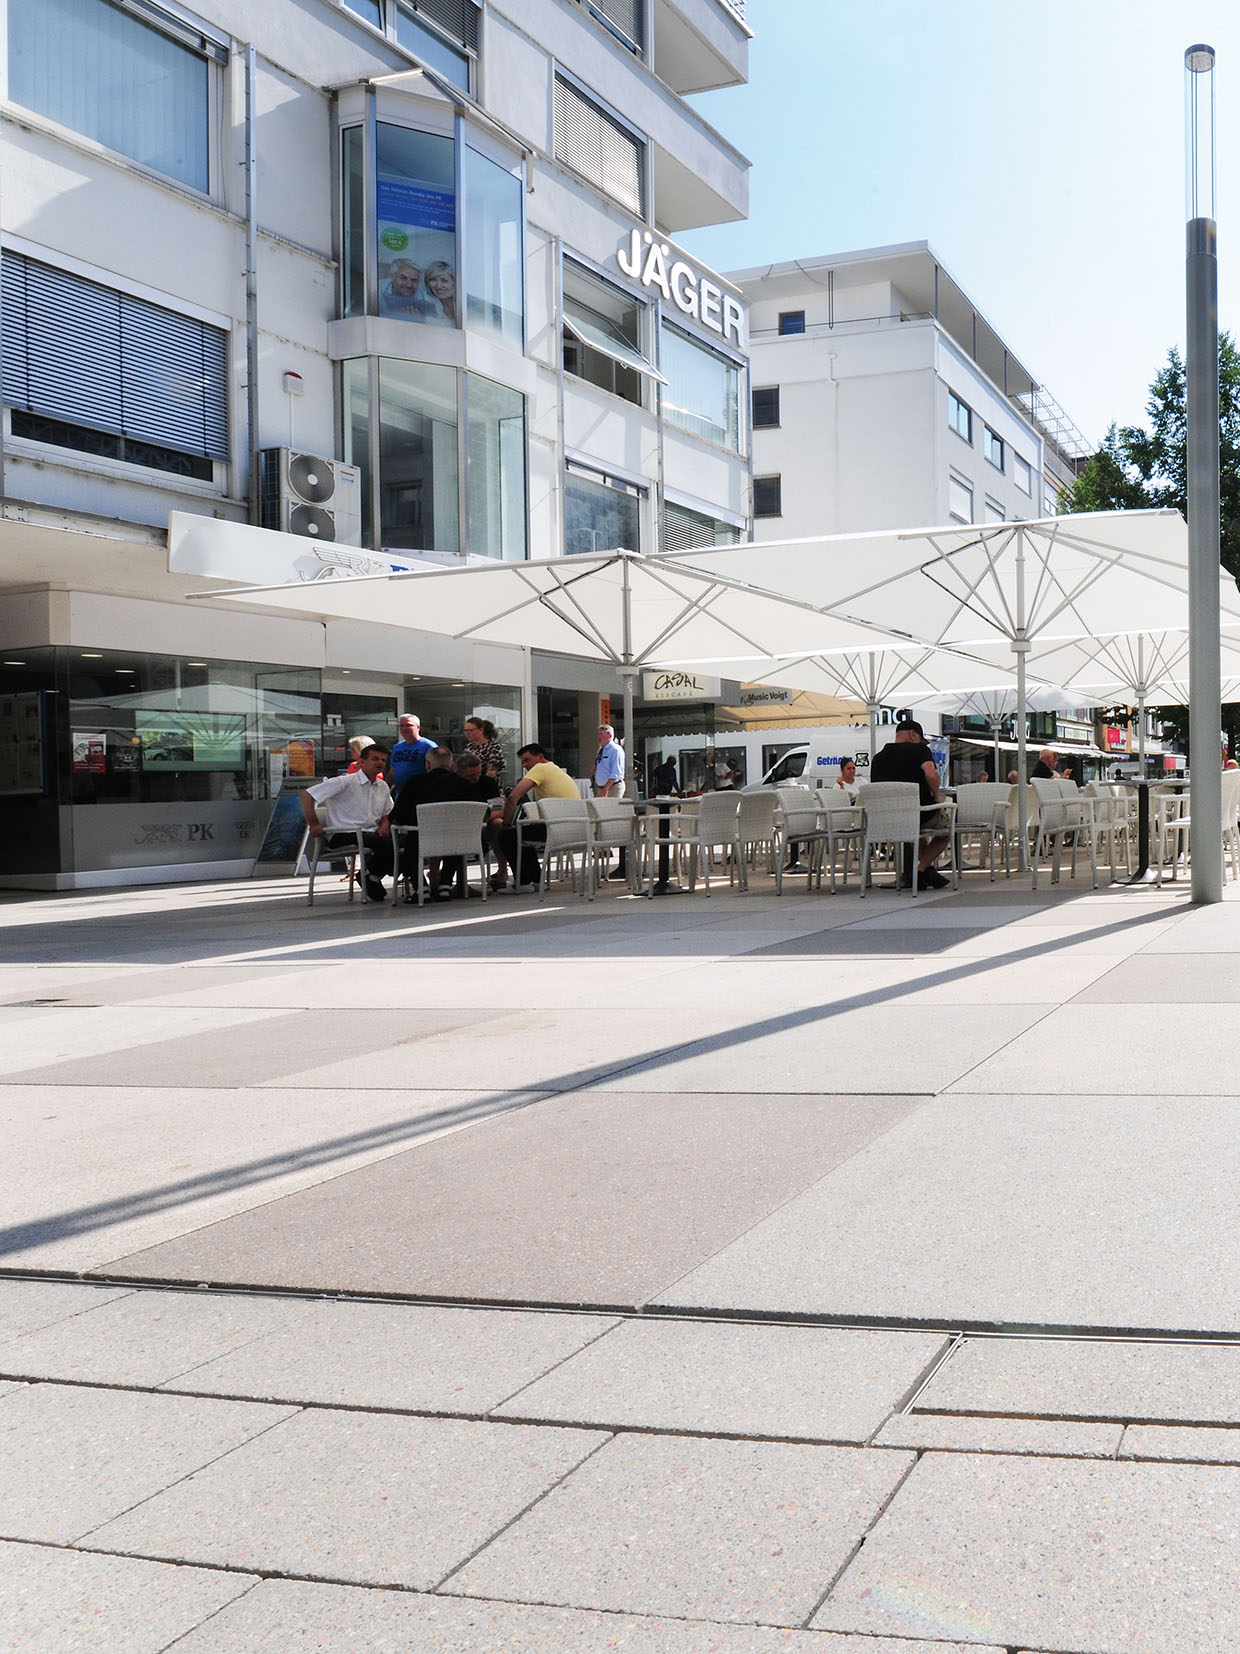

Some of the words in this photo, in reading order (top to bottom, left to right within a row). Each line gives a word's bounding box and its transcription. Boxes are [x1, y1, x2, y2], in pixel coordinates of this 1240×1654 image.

[617, 229, 744, 348] JÄGER
[654, 673, 704, 690] CASAL
[748, 693, 769, 701] Music
[769, 691, 788, 701] Voigt
[187, 824, 214, 841] PK
